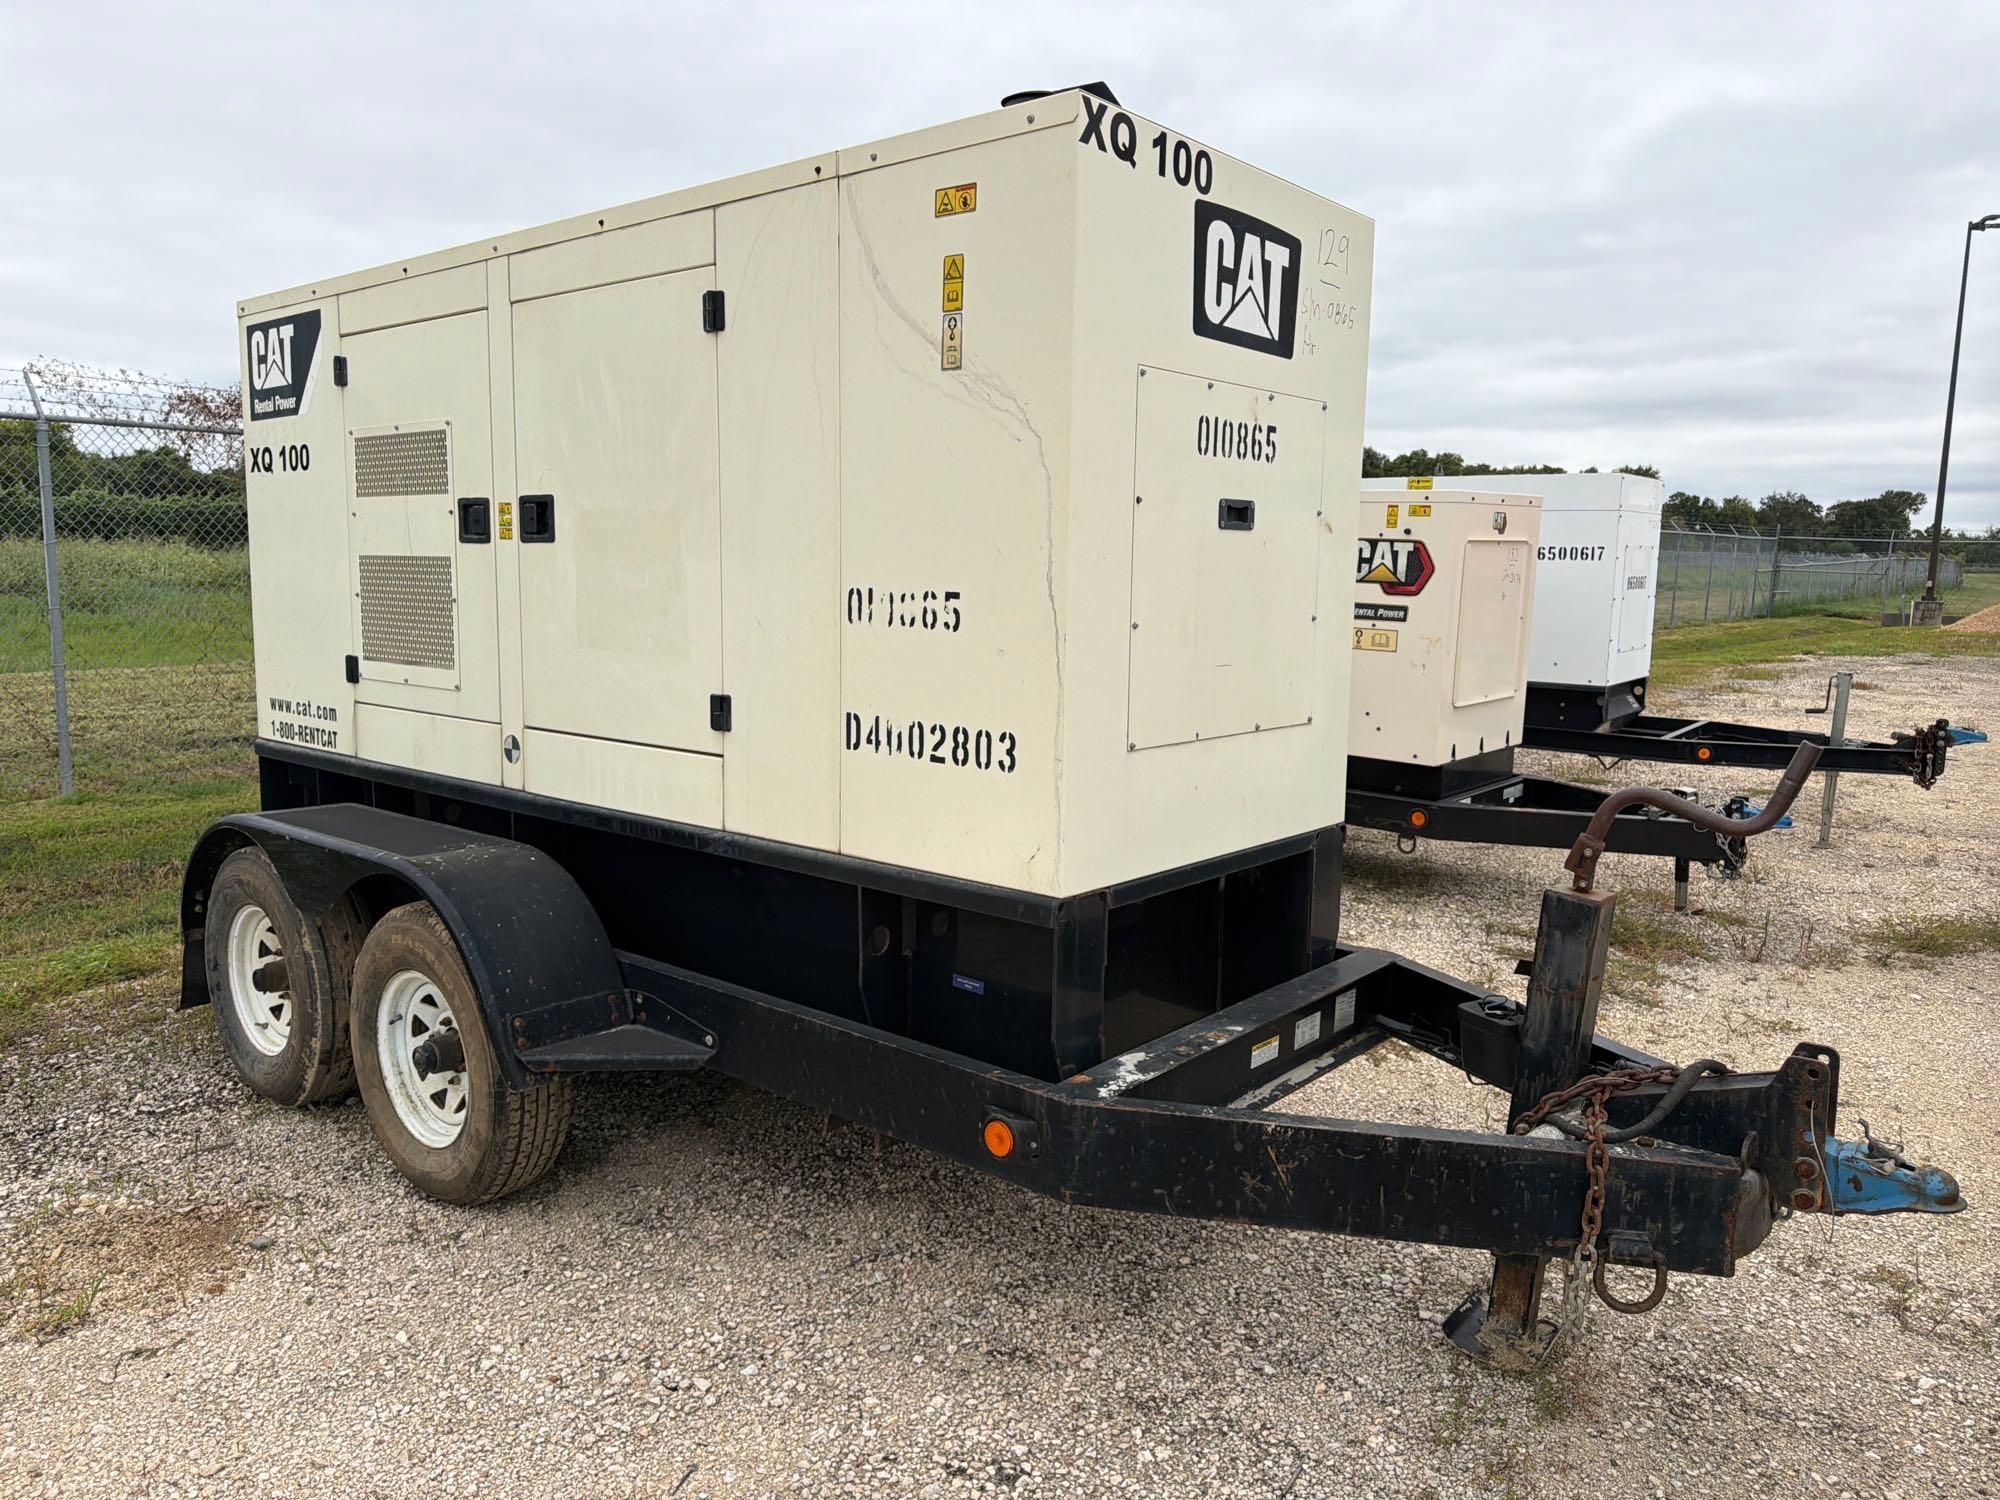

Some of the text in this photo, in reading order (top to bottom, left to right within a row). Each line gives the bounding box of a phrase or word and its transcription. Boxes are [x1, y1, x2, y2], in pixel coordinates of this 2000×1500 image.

[1079, 94, 1212, 195] XQ 100
[1318, 228, 1350, 275] 129
[1204, 219, 1290, 341] CAT
[251, 324, 294, 390] CAT
[254, 395, 296, 413] Rental Power
[250, 444, 310, 474] XQ 100
[1197, 415, 1277, 464] 010865
[1357, 540, 1414, 582] CAT
[1377, 608, 1405, 619] POWER
[270, 697, 337, 722] www.cat.com
[271, 720, 338, 749] 1-800-RENTCAT
